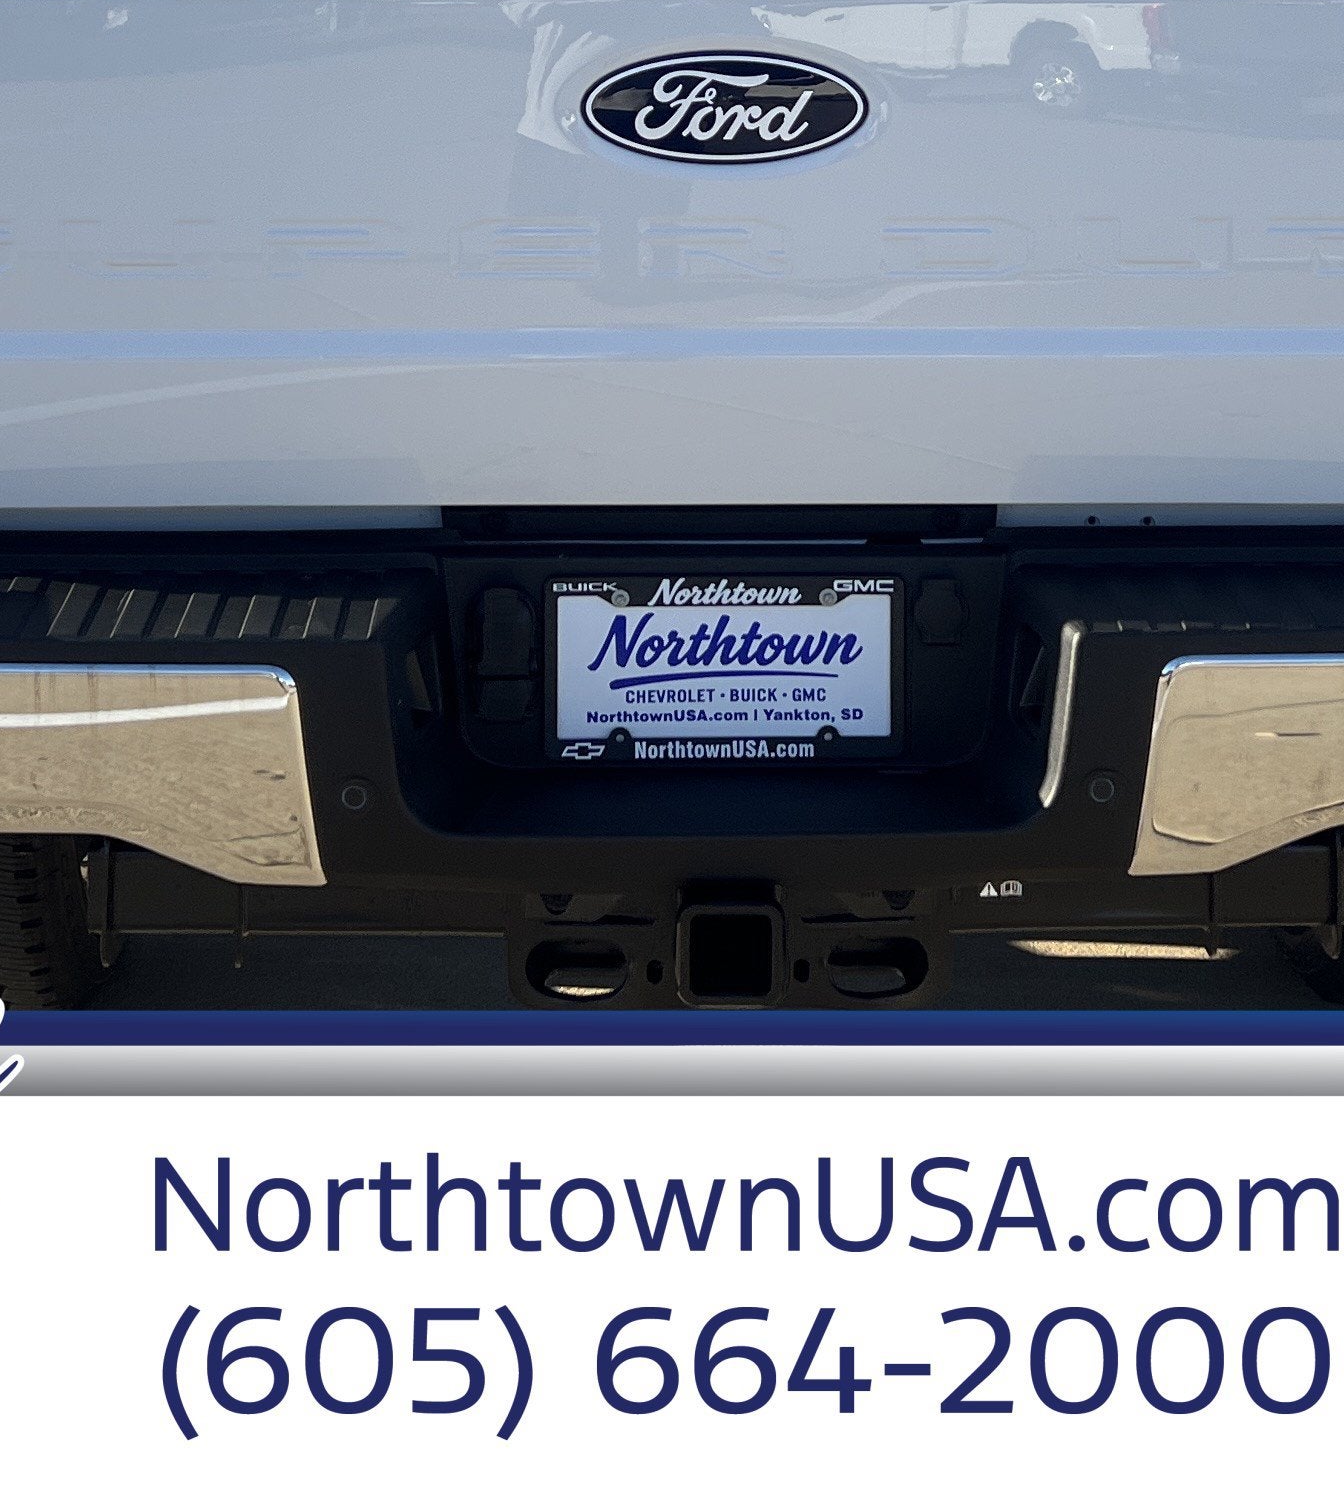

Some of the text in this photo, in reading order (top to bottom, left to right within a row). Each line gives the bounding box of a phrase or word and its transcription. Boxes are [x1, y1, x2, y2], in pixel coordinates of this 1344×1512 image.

[634, 69, 814, 142] Ford
[552, 581, 618, 593] BUICK
[647, 577, 803, 607] Northtown
[832, 579, 895, 593] GMC
[587, 612, 864, 671] Northtown
[625, 687, 826, 704] CHEVROLET BUICK GMC
[586, 707, 864, 723] NorthtownUSA.com Yankton, SD
[634, 739, 815, 759] NorthtownUSA.com
